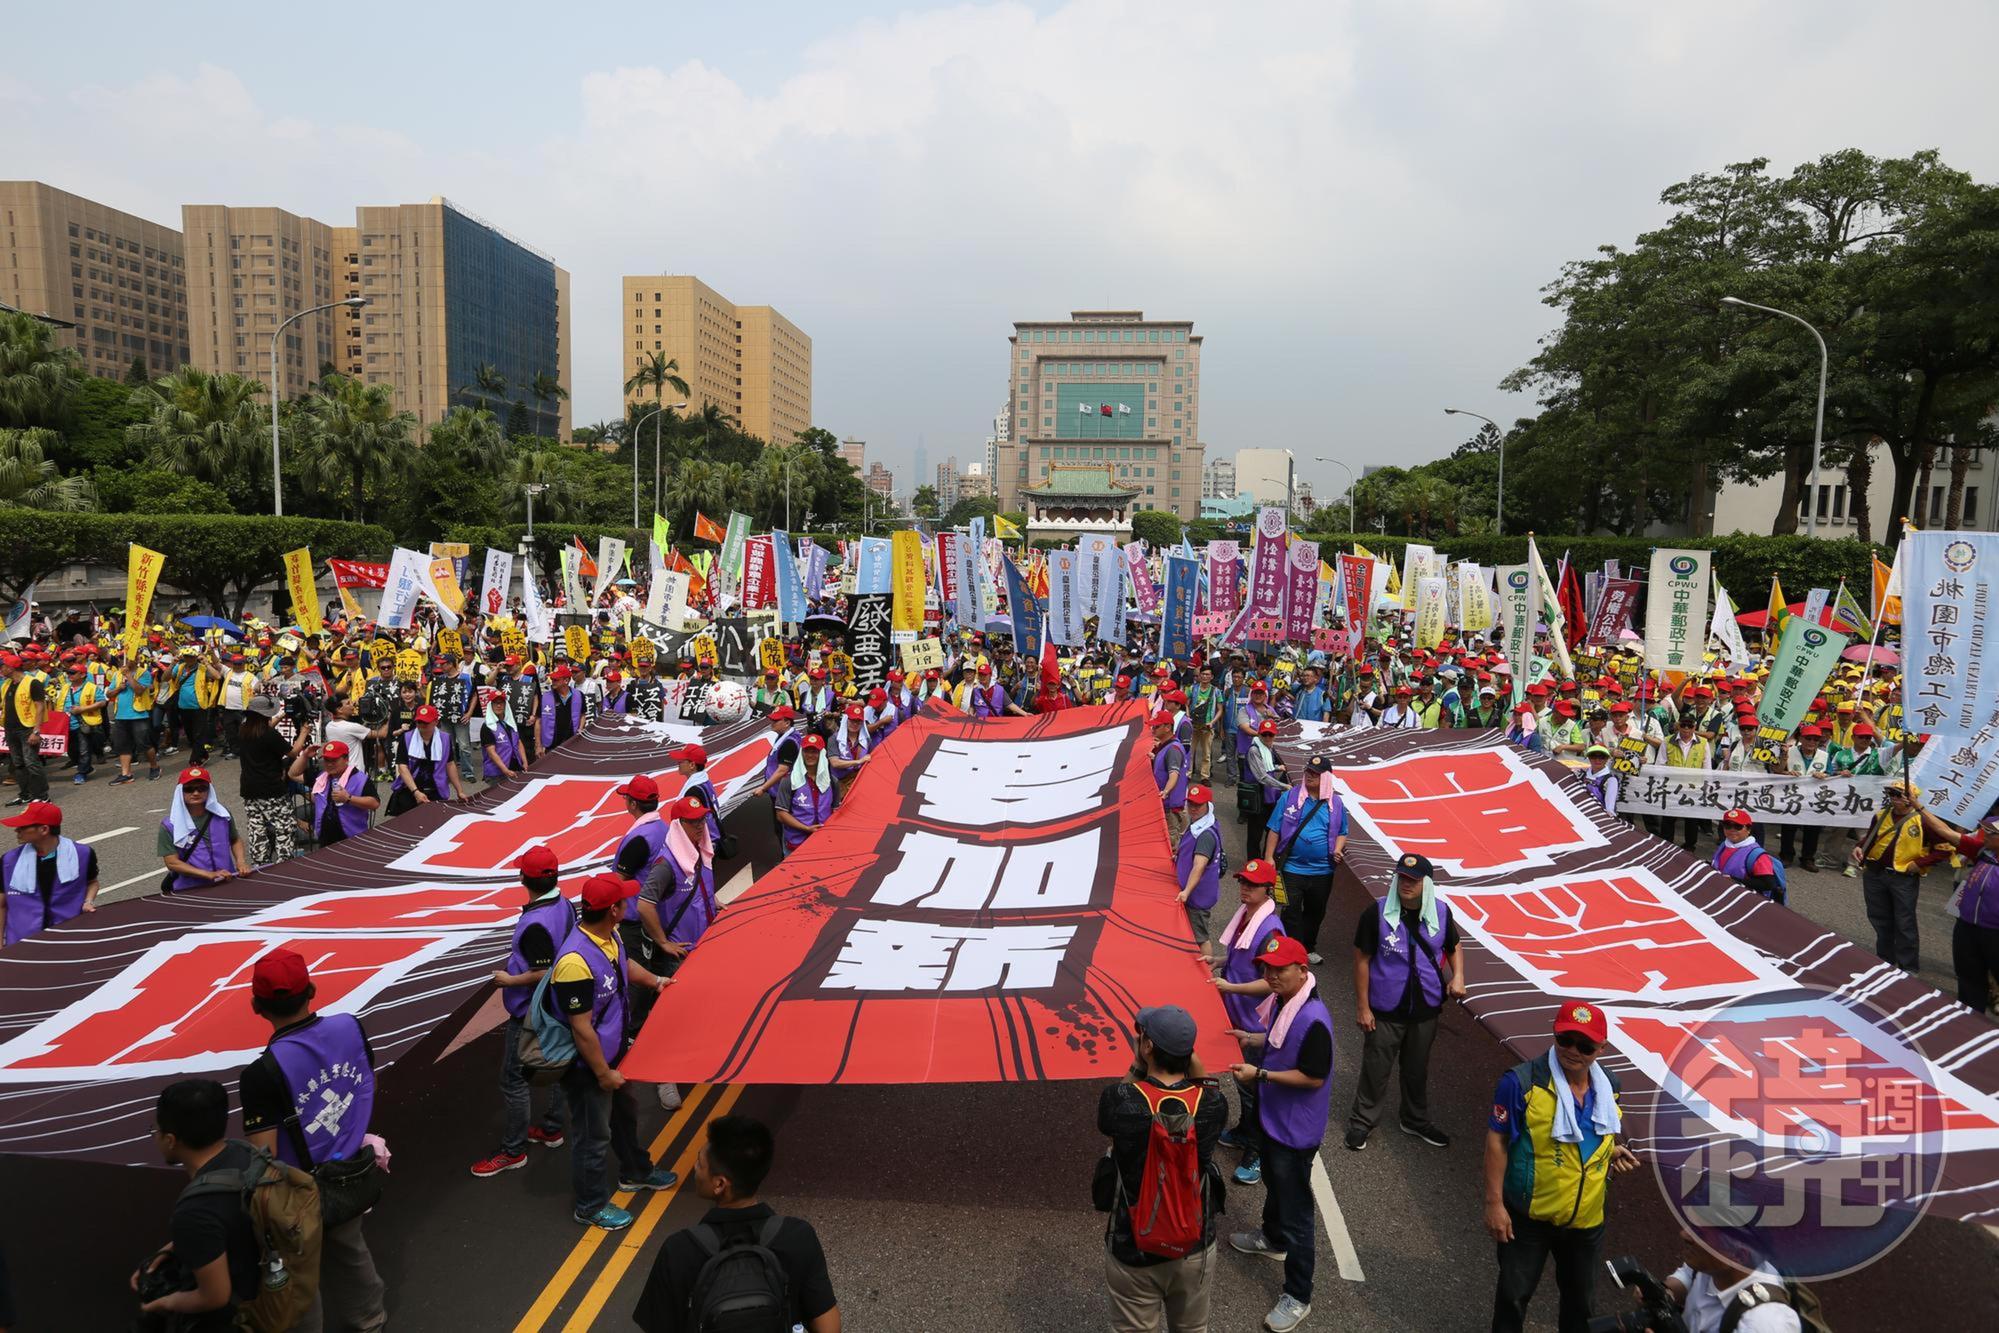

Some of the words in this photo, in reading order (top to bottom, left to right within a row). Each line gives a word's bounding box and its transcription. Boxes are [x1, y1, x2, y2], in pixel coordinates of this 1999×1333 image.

[1667, 580, 1698, 589] CPWU
[1510, 602, 1527, 675] 中華郵政工會
[1667, 589, 1690, 666] 中華郵政工會
[1795, 644, 1820, 659] CPWU
[682, 686, 699, 717] 工會
[1774, 655, 1810, 720] 中華郵政工會
[1613, 758, 1641, 776] 10%
[1752, 747, 1780, 765] 10%
[819, 725, 1130, 992] 要加薪
